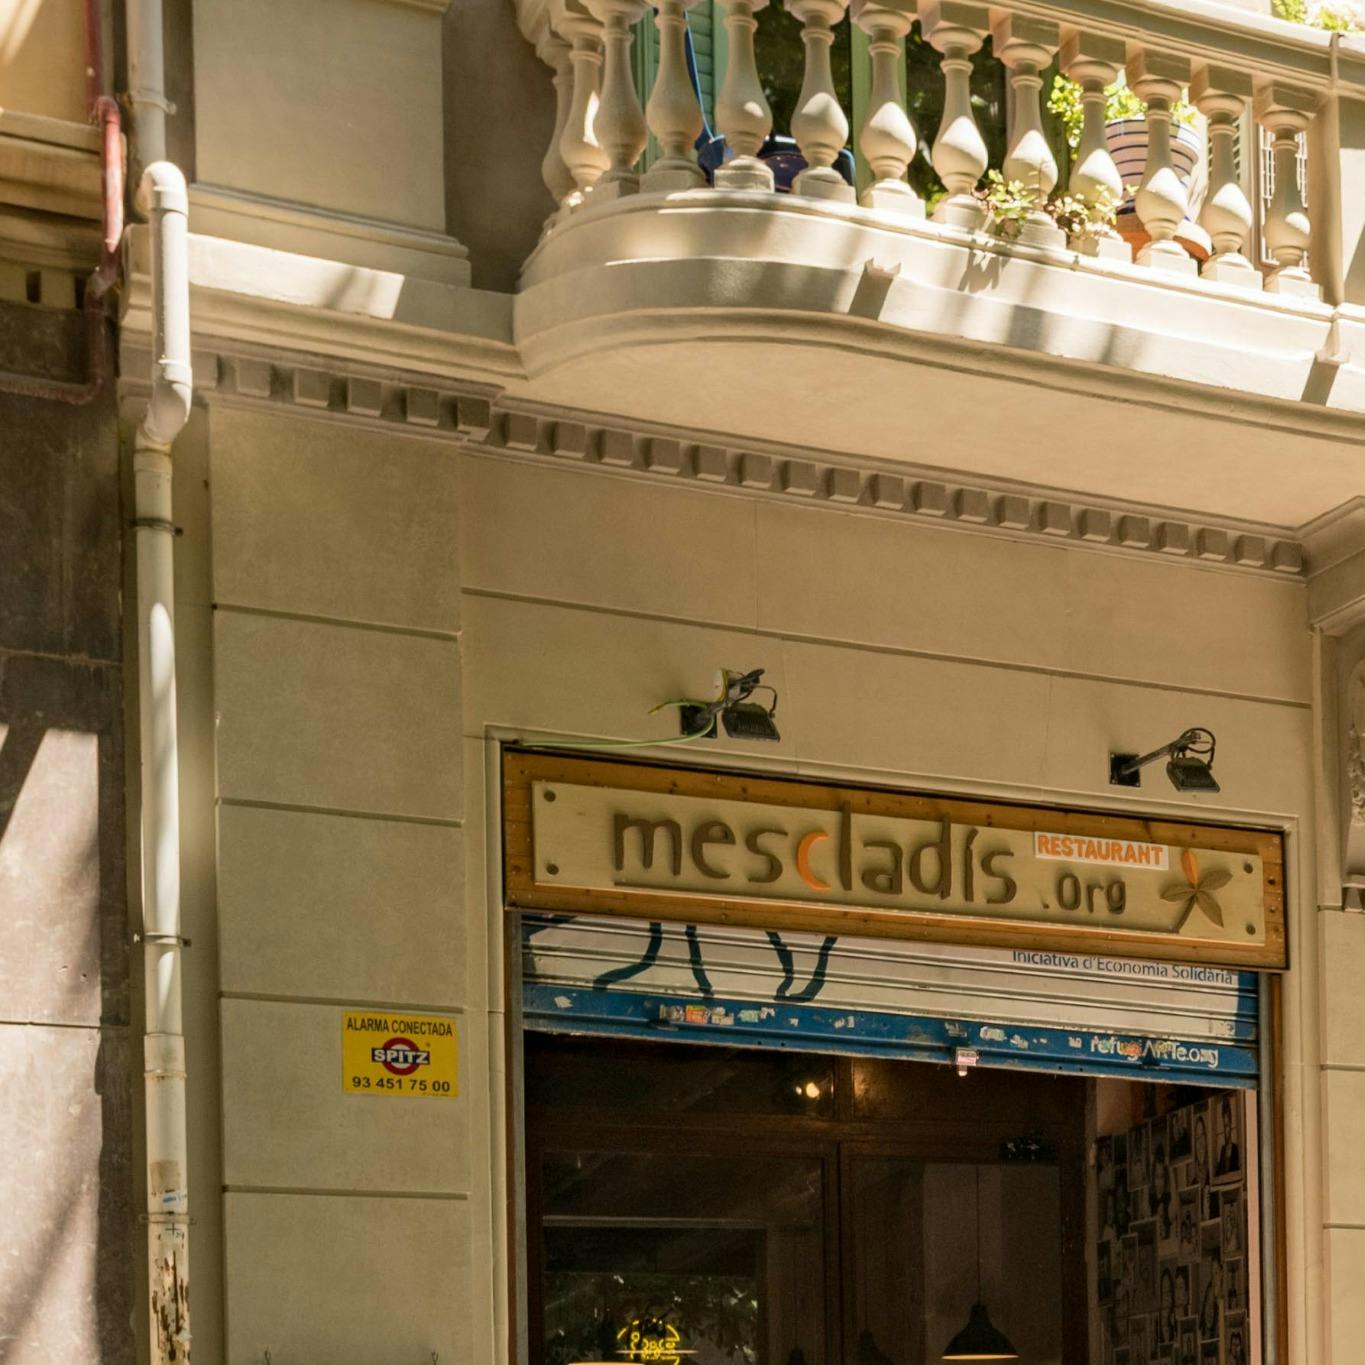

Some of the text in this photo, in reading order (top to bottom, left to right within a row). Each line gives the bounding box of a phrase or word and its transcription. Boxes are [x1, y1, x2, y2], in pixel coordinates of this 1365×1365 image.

[1036, 834, 1164, 866] RESTAURANT
[1012, 949, 1079, 969] Iniciativa
[346, 1017, 453, 1037] ALARMA CONECTADA
[374, 1049, 428, 1064] SPITZ
[352, 1076, 451, 1093] 93 451 75 00
